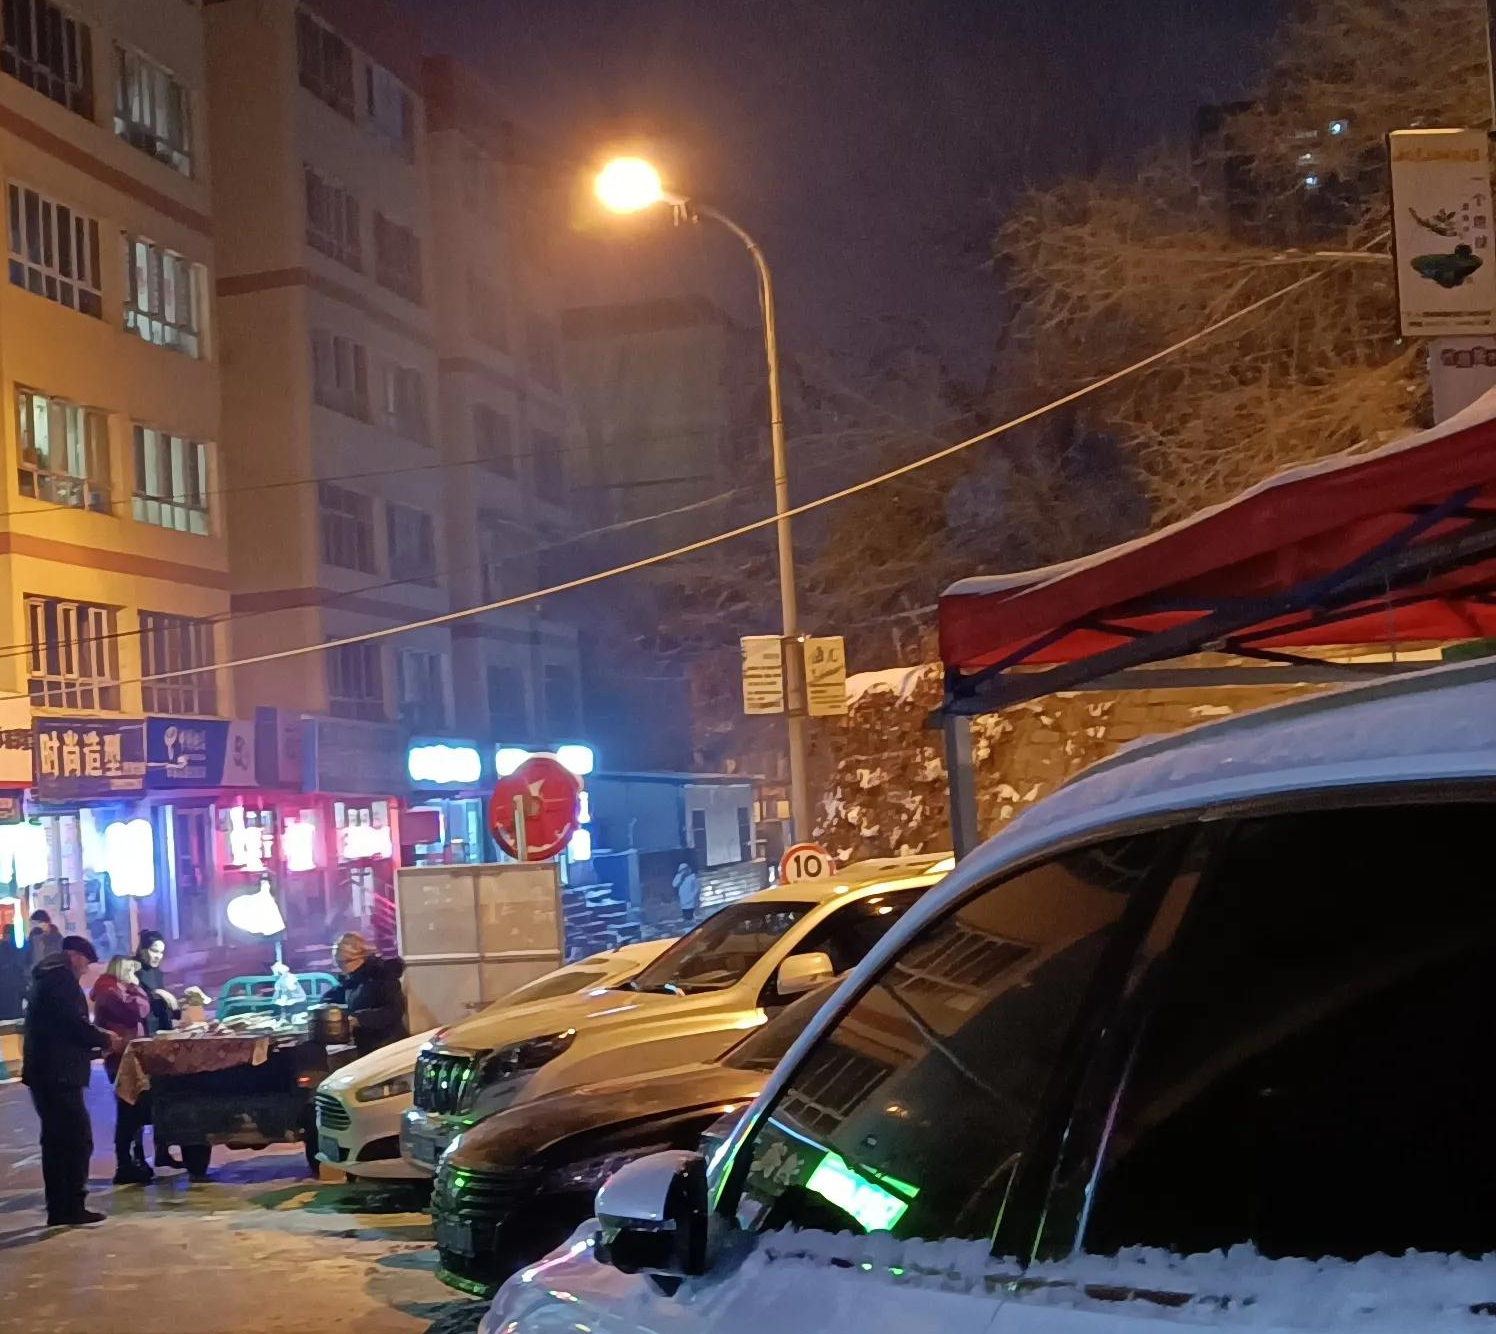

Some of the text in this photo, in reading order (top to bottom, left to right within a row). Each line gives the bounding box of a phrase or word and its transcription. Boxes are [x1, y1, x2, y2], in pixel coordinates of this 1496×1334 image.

[39, 730, 122, 778] 时尚造型
[794, 854, 822, 878] 10
